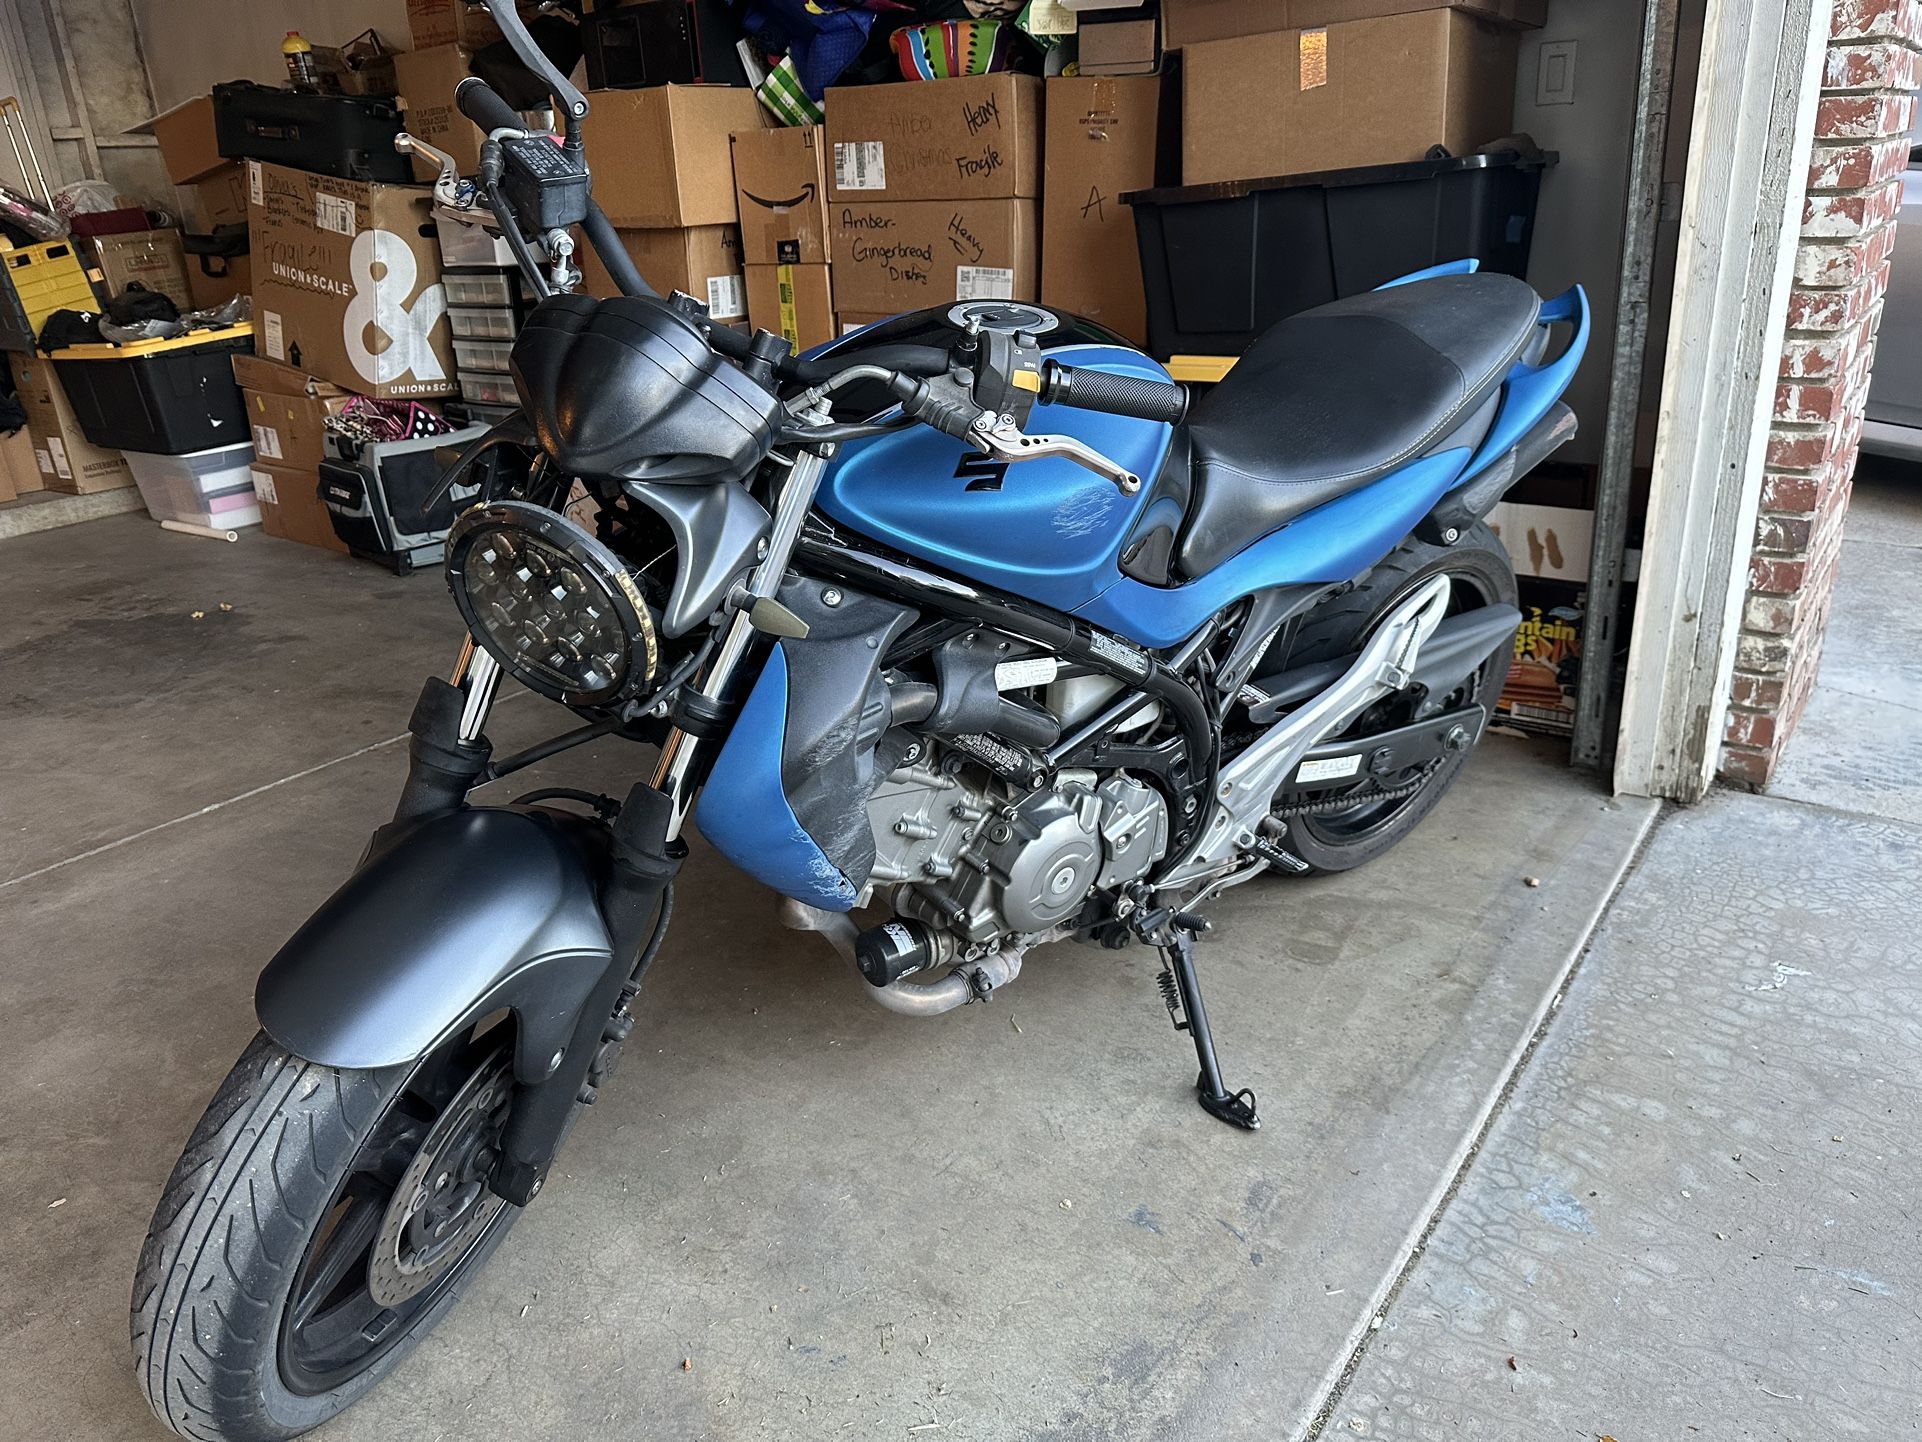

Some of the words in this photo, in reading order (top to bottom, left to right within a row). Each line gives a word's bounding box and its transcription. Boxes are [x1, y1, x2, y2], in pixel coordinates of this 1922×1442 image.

[963, 92, 1001, 136] Heavy
[955, 144, 1004, 179] Fragile
[1081, 185, 1107, 222] A
[852, 237, 934, 268] Gingerbread
[948, 212, 984, 263] Heavy
[1519, 617, 1576, 641] ntain
